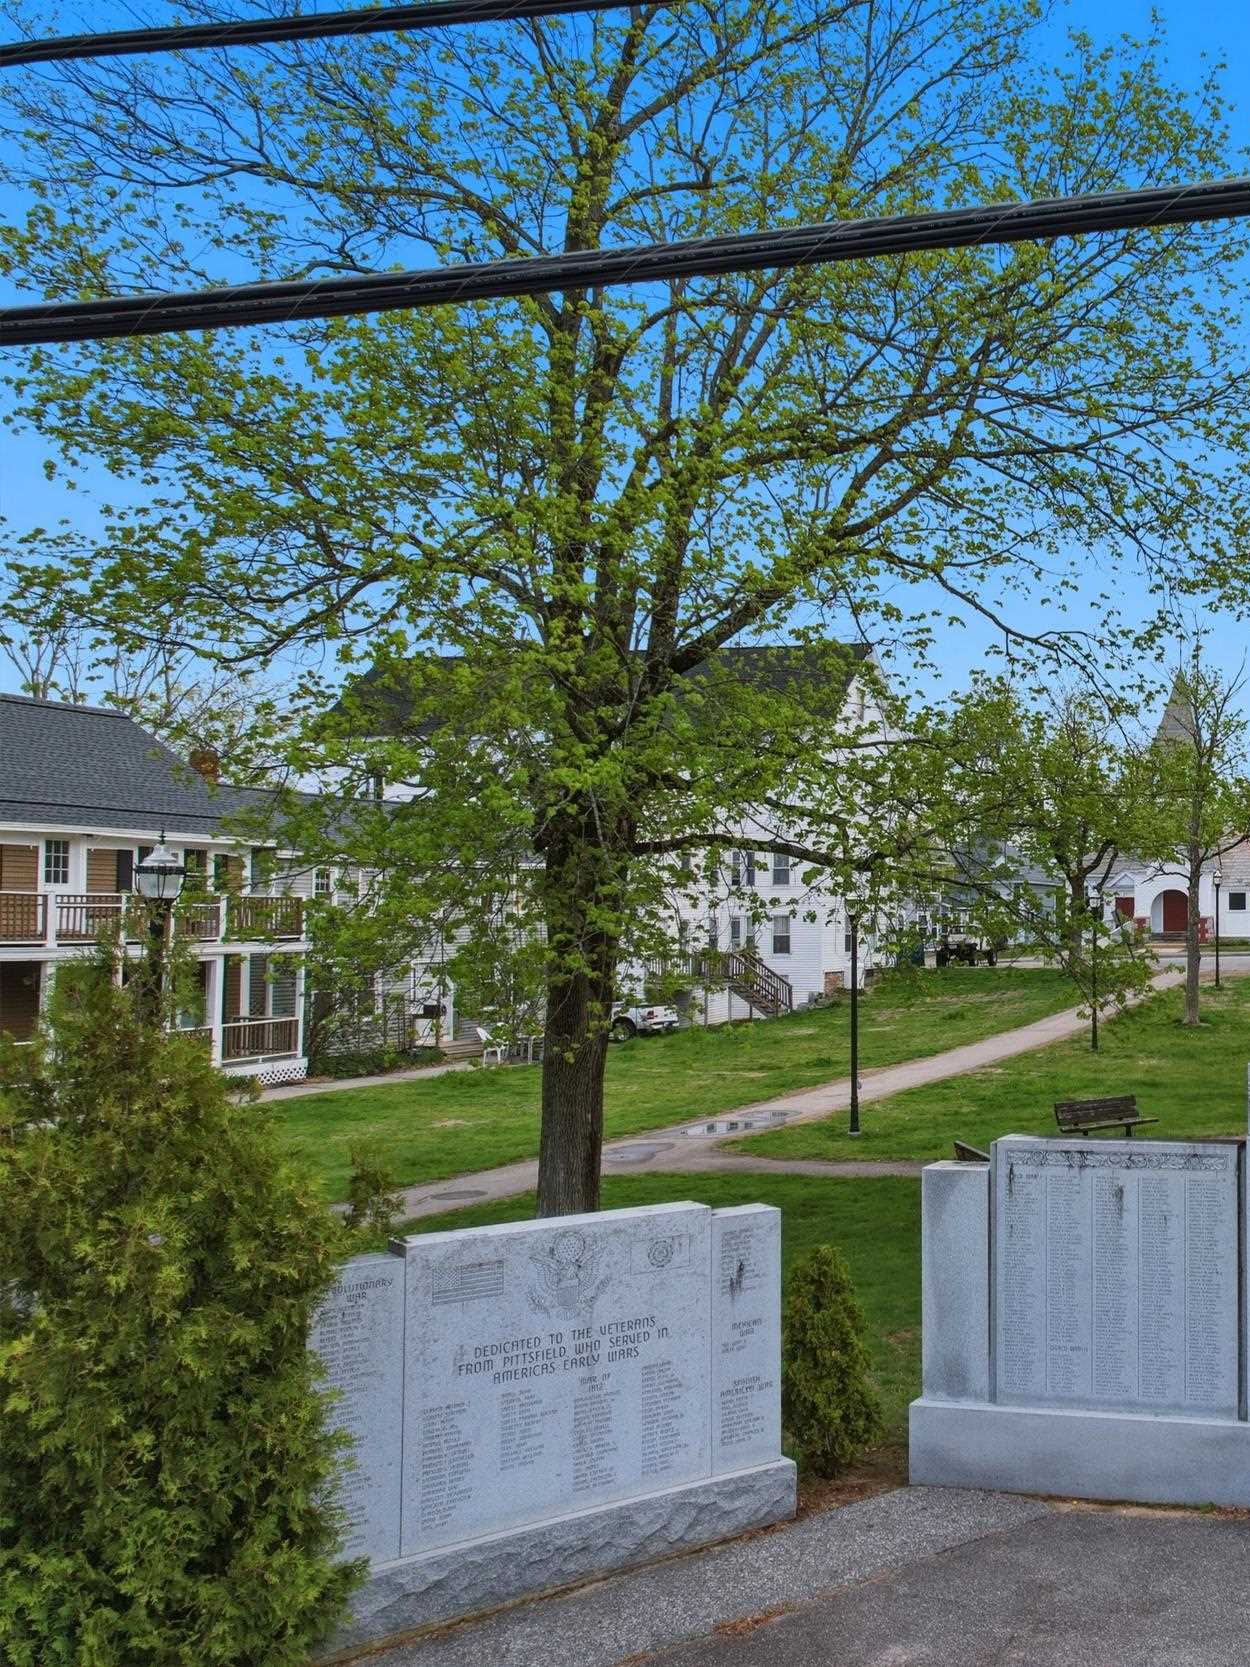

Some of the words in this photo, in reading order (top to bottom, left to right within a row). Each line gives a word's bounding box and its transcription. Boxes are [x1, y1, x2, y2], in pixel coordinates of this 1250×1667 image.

[458, 1359, 493, 1376] FROM
[503, 1346, 566, 1367] PITTSFIELD
[575, 1340, 600, 1355] WHO
[609, 1331, 650, 1348] SERVED
[658, 1327, 668, 1338] IN
[475, 1336, 541, 1359] DEDICATED
[550, 1332, 563, 1345] TO
[571, 1328, 592, 1341] THE
[600, 1316, 656, 1336] VETERANS
[493, 1364, 555, 1385] AMERICAS
[563, 1354, 600, 1371] EARLY
[608, 1346, 639, 1363] WARS
